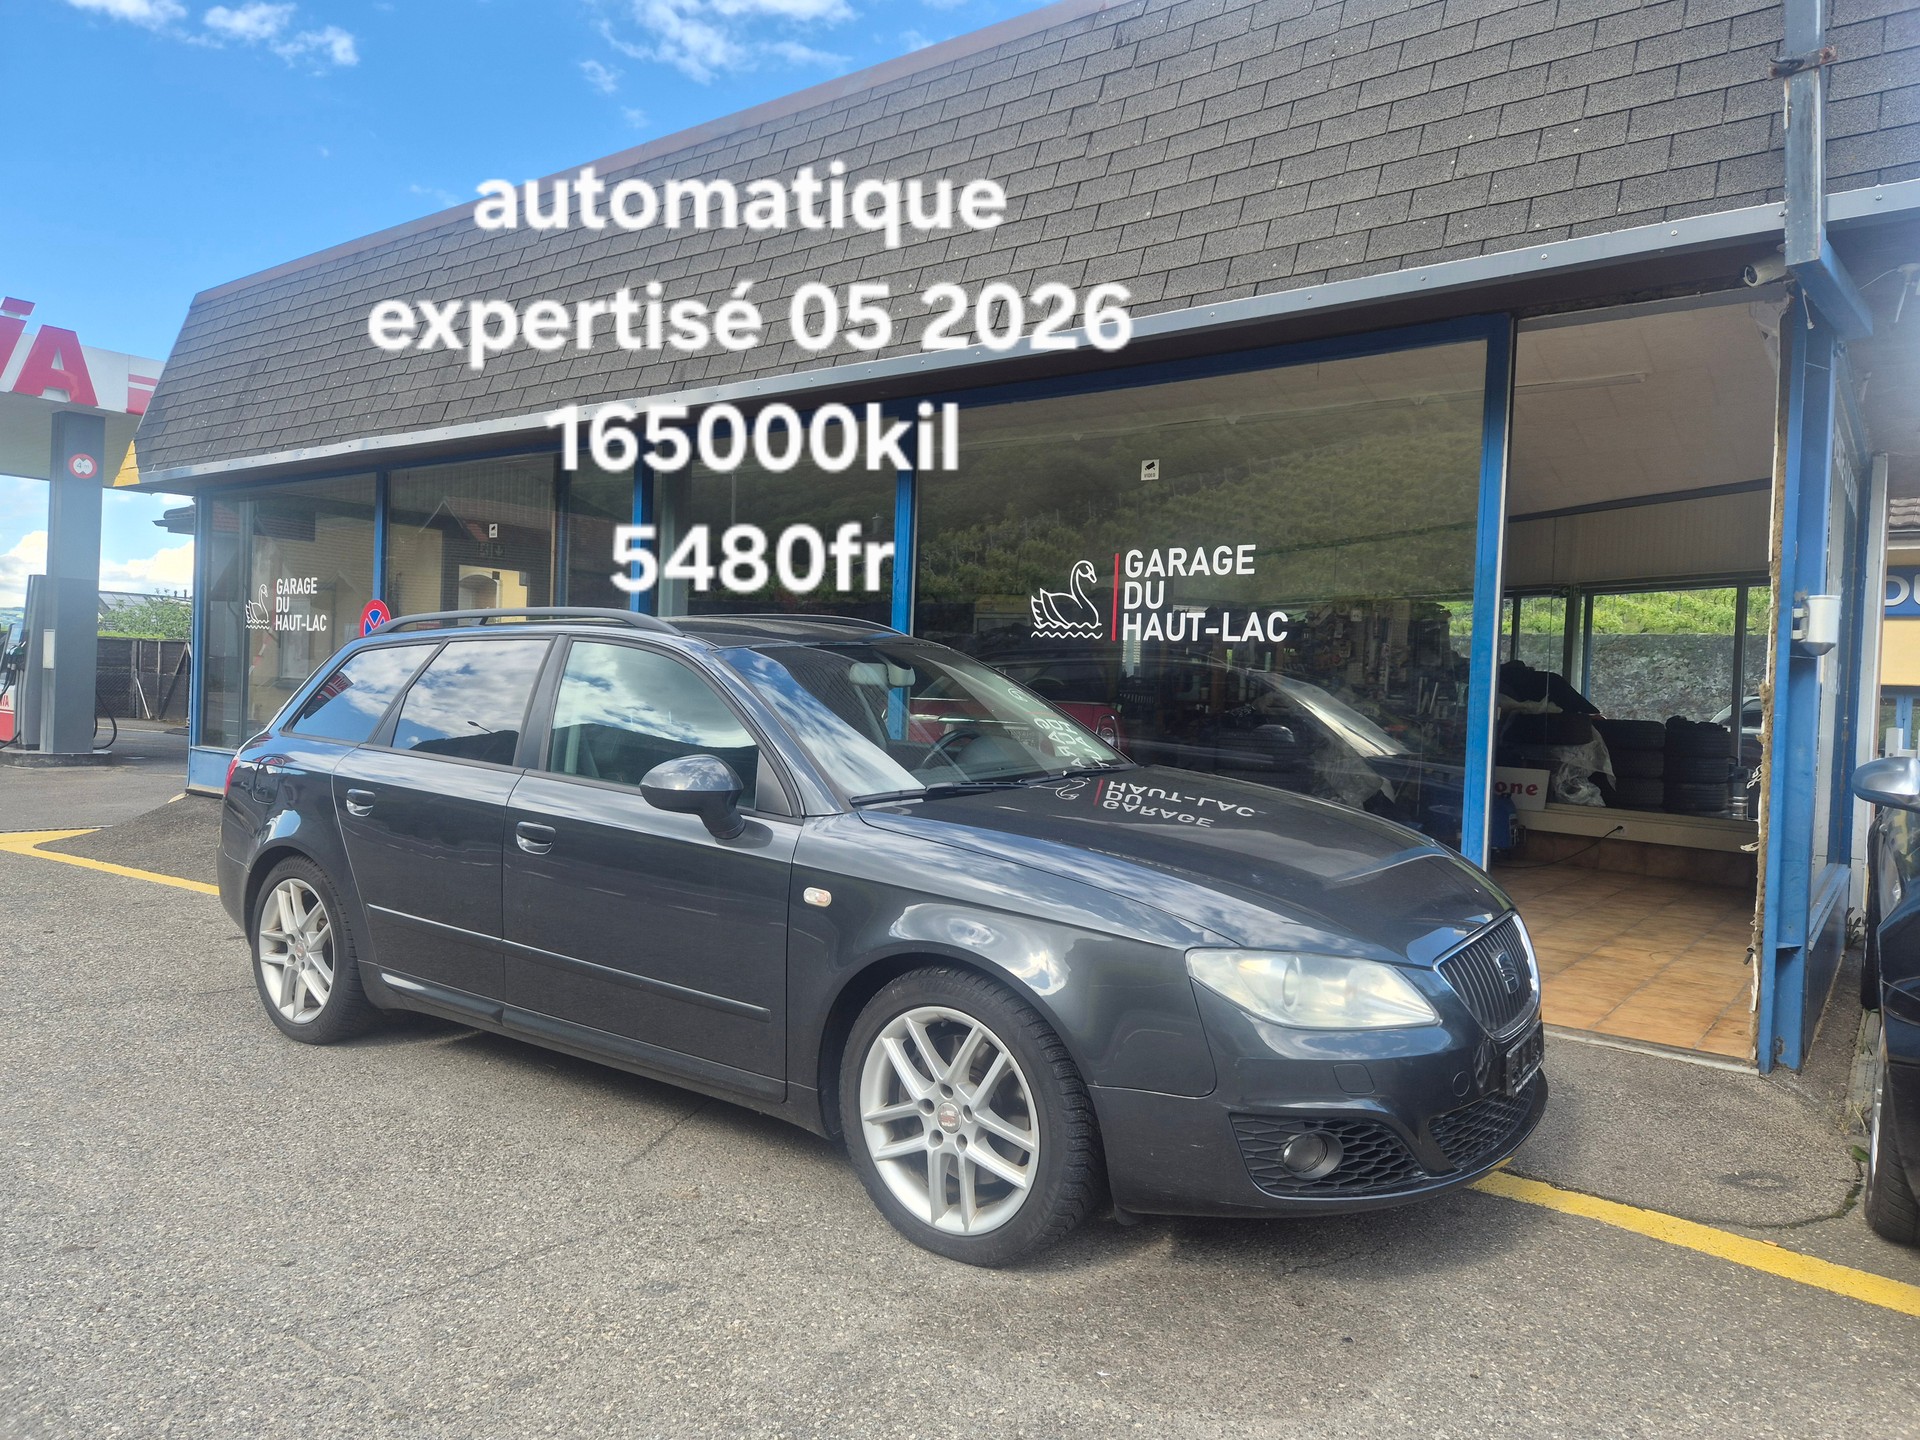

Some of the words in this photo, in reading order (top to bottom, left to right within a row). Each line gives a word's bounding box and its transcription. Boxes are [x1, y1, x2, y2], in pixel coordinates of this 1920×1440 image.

[1124, 544, 1257, 579] GARAGE
[276, 577, 318, 595] GARAGE
[275, 596, 290, 613] DU
[1123, 581, 1165, 610] DU
[275, 614, 327, 632] HAUT-LAC
[1122, 611, 1289, 643] HAUT-LAC
[1494, 780, 1539, 796] one
